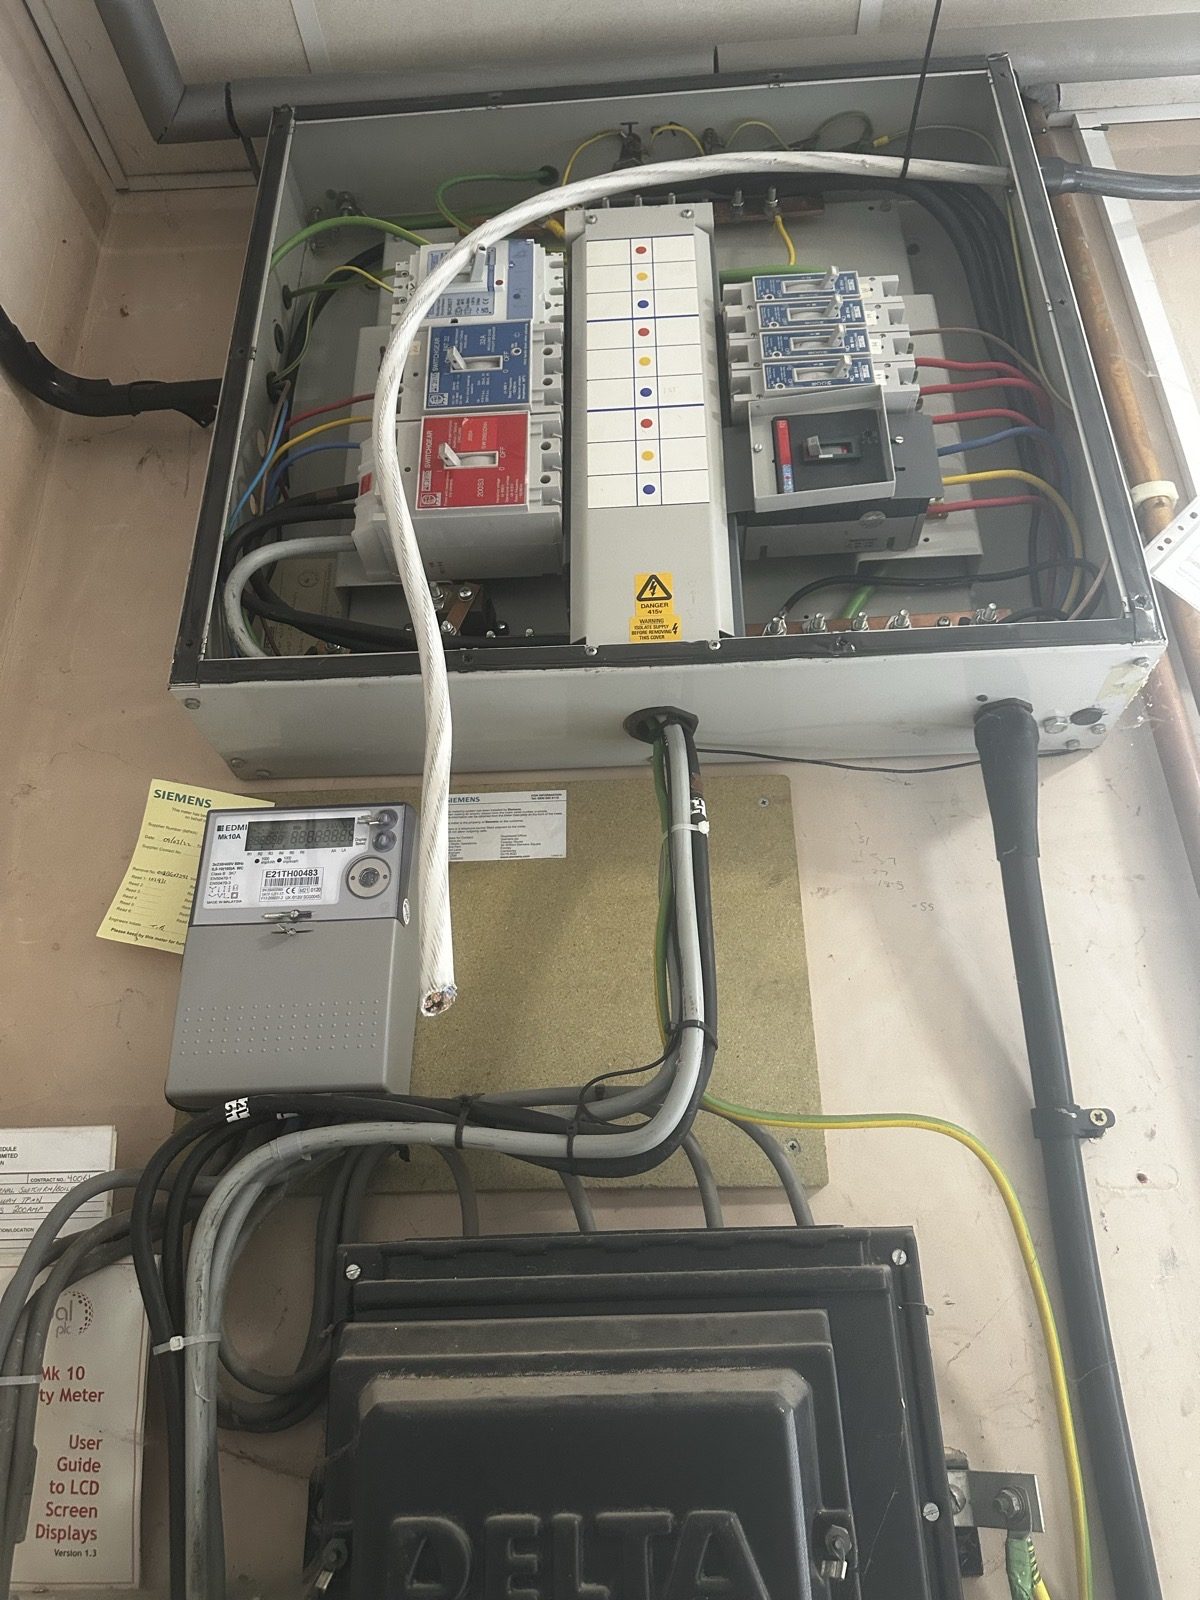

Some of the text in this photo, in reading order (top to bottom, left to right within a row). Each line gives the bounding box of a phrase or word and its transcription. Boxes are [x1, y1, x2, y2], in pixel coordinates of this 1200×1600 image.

[424, 430, 433, 469] SWITCHGEAR
[153, 789, 212, 808] SIEMENS
[225, 824, 247, 832] EDMI
[265, 869, 318, 878] E21TH00483
[42, 1366, 85, 1380] Mk 10
[59, 1388, 104, 1402] Meter
[69, 1434, 103, 1450] User
[57, 1456, 101, 1473] Guide
[49, 1480, 99, 1495] to LCD
[45, 1502, 98, 1518] Screen
[35, 1523, 97, 1544] Displays
[54, 1549, 97, 1557] Version 1.3
[390, 1508, 775, 1600] DELTA
